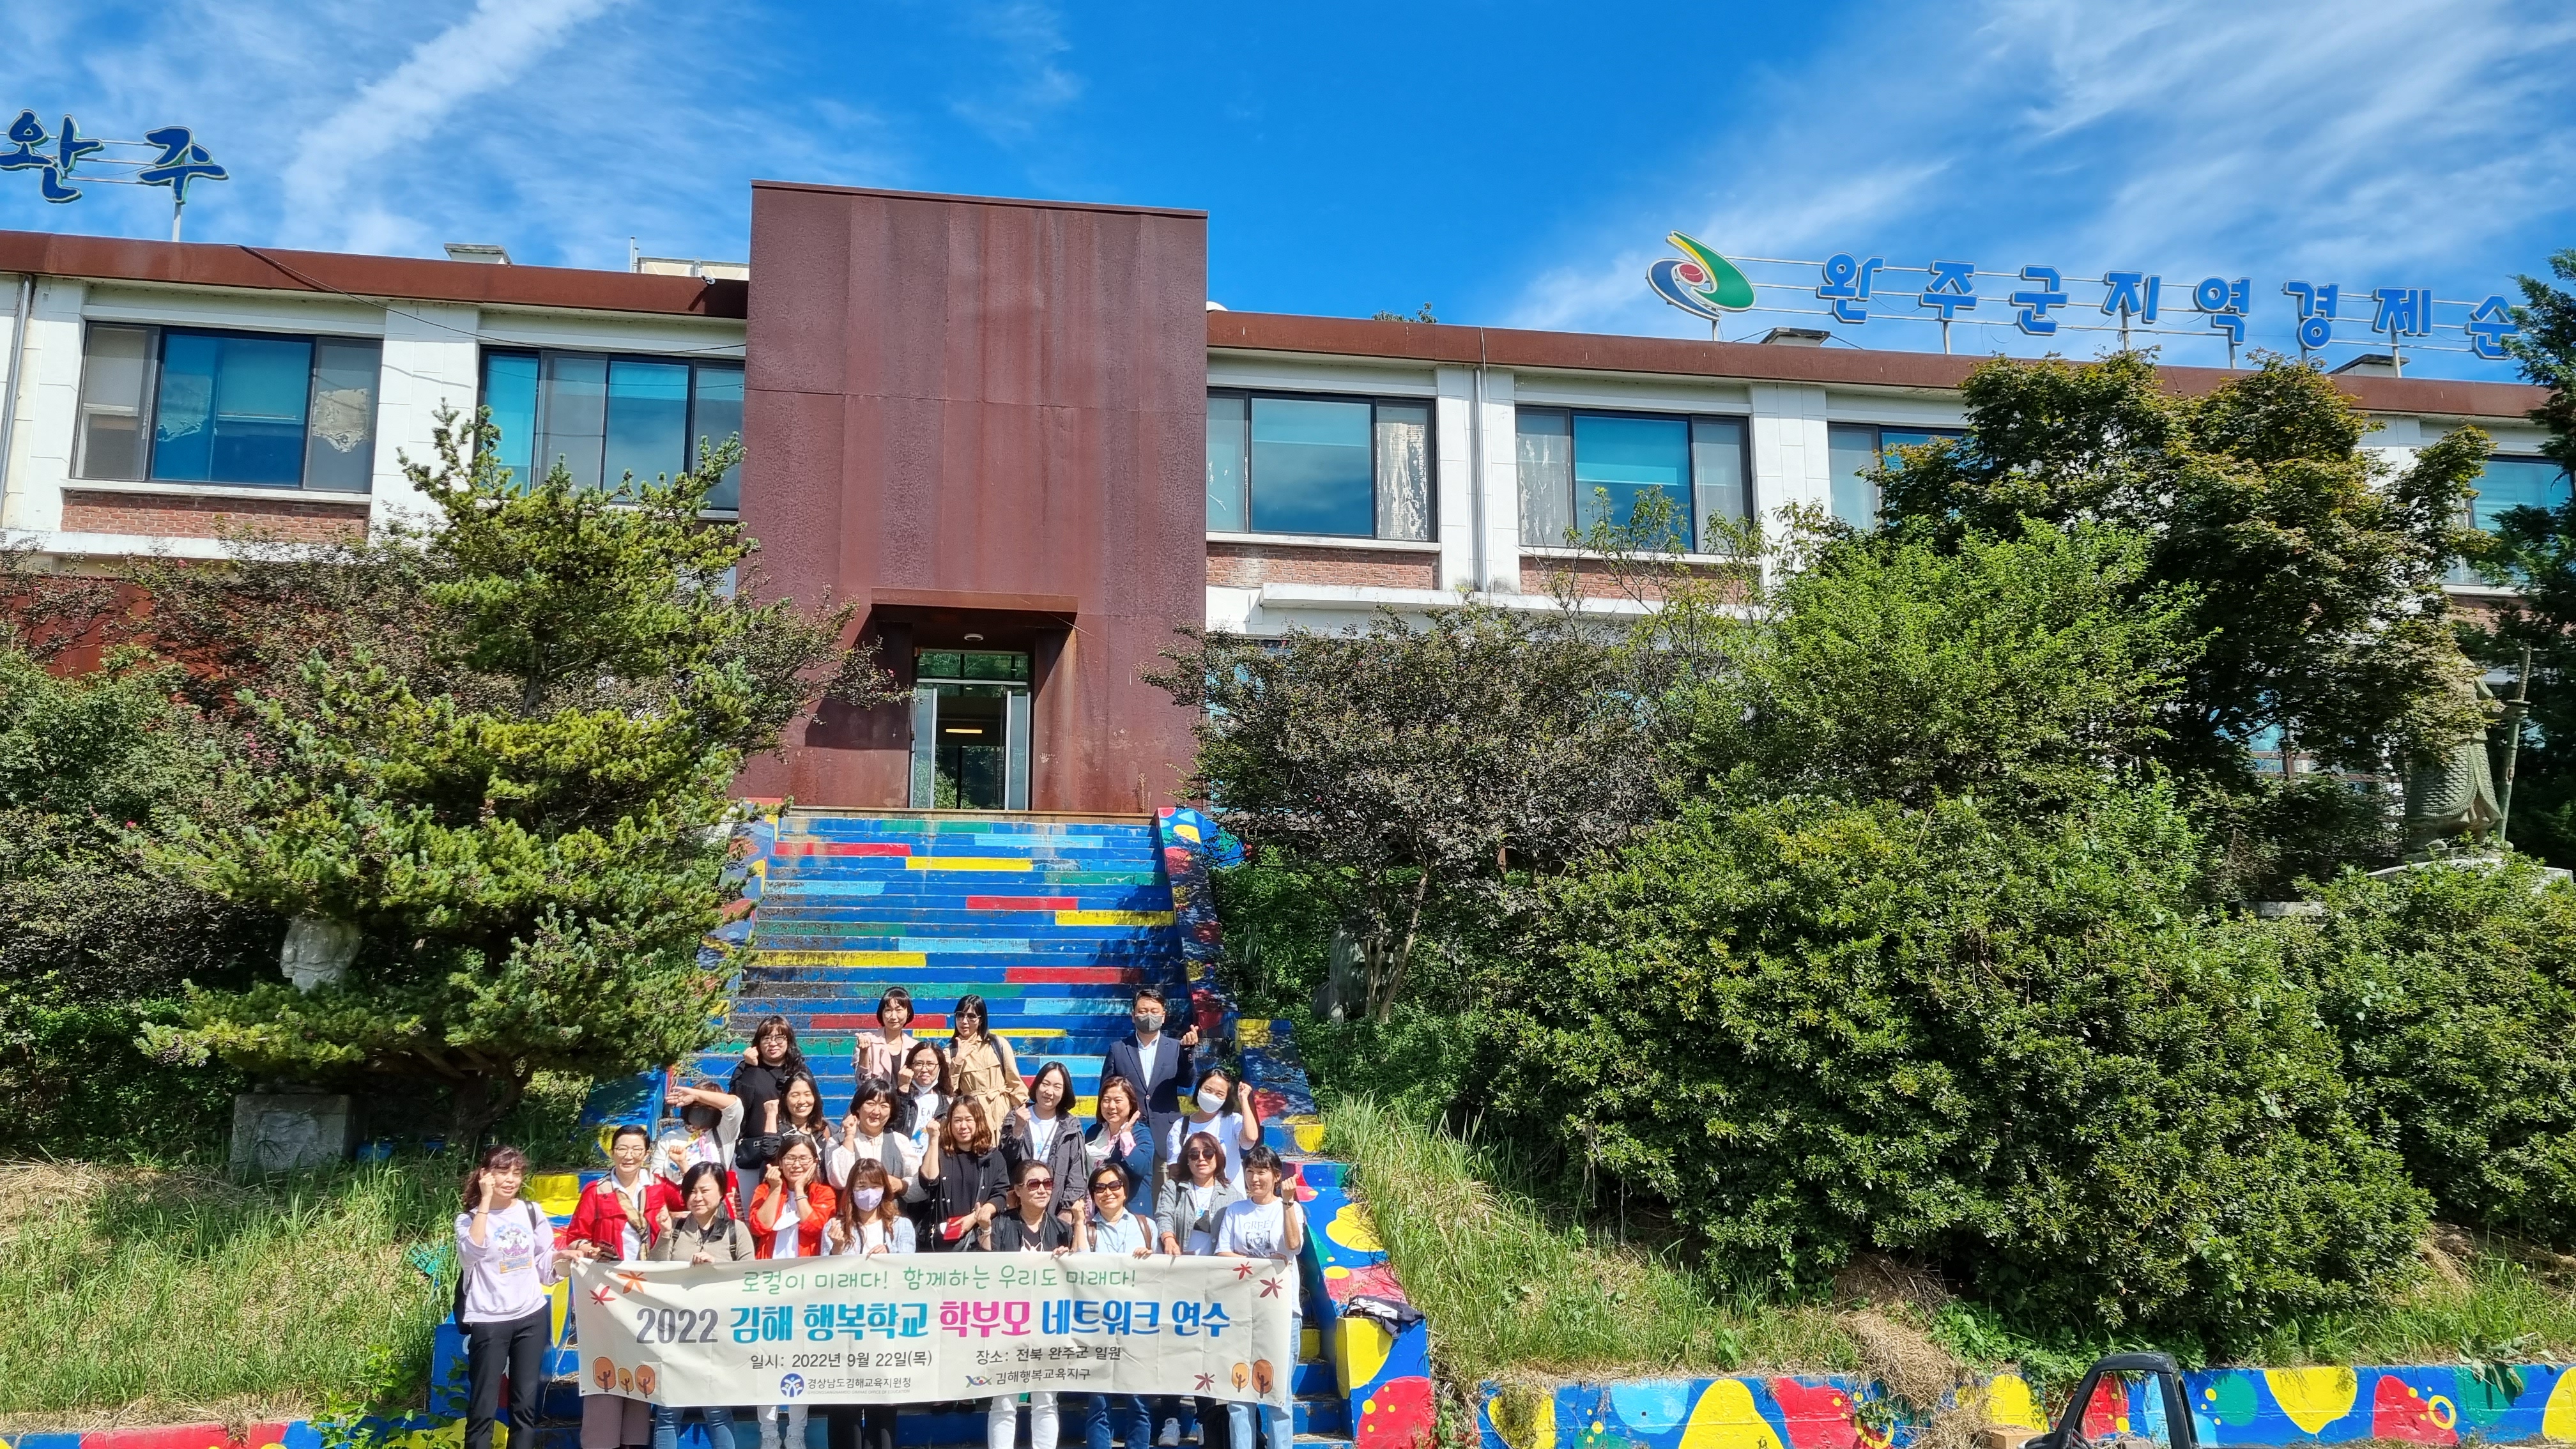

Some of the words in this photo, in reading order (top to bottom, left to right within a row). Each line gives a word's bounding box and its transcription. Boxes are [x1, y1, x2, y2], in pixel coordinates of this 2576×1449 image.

[0, 109, 229, 204] 완주
[741, 1270, 804, 1294] 로컬이
[815, 1271, 887, 1290] 미래다!
[903, 1266, 990, 1290] 함께하는
[998, 1264, 1058, 1287] 우리도
[1065, 1268, 1136, 1288] 미래다!
[636, 1308, 719, 1344] 2022
[730, 1304, 793, 1344] 김해
[803, 1302, 929, 1342] 행복학교
[939, 1300, 1031, 1338] 학부모
[1041, 1298, 1161, 1337] 네트워크
[1171, 1300, 1230, 1338] 연수
[751, 1354, 785, 1370] 일시:
[792, 1353, 841, 1368] 2022년
[847, 1352, 870, 1367] 9월
[875, 1350, 932, 1367] 22일(목)
[976, 1350, 1009, 1365] 장소:
[1016, 1347, 1043, 1361] 전북
[1048, 1346, 1089, 1360] 완주군
[1095, 1346, 1121, 1360] 일원
[808, 1377, 911, 1389] 경상남도김해교육지원청
[996, 1368, 1091, 1384] 김해행복교육지구
